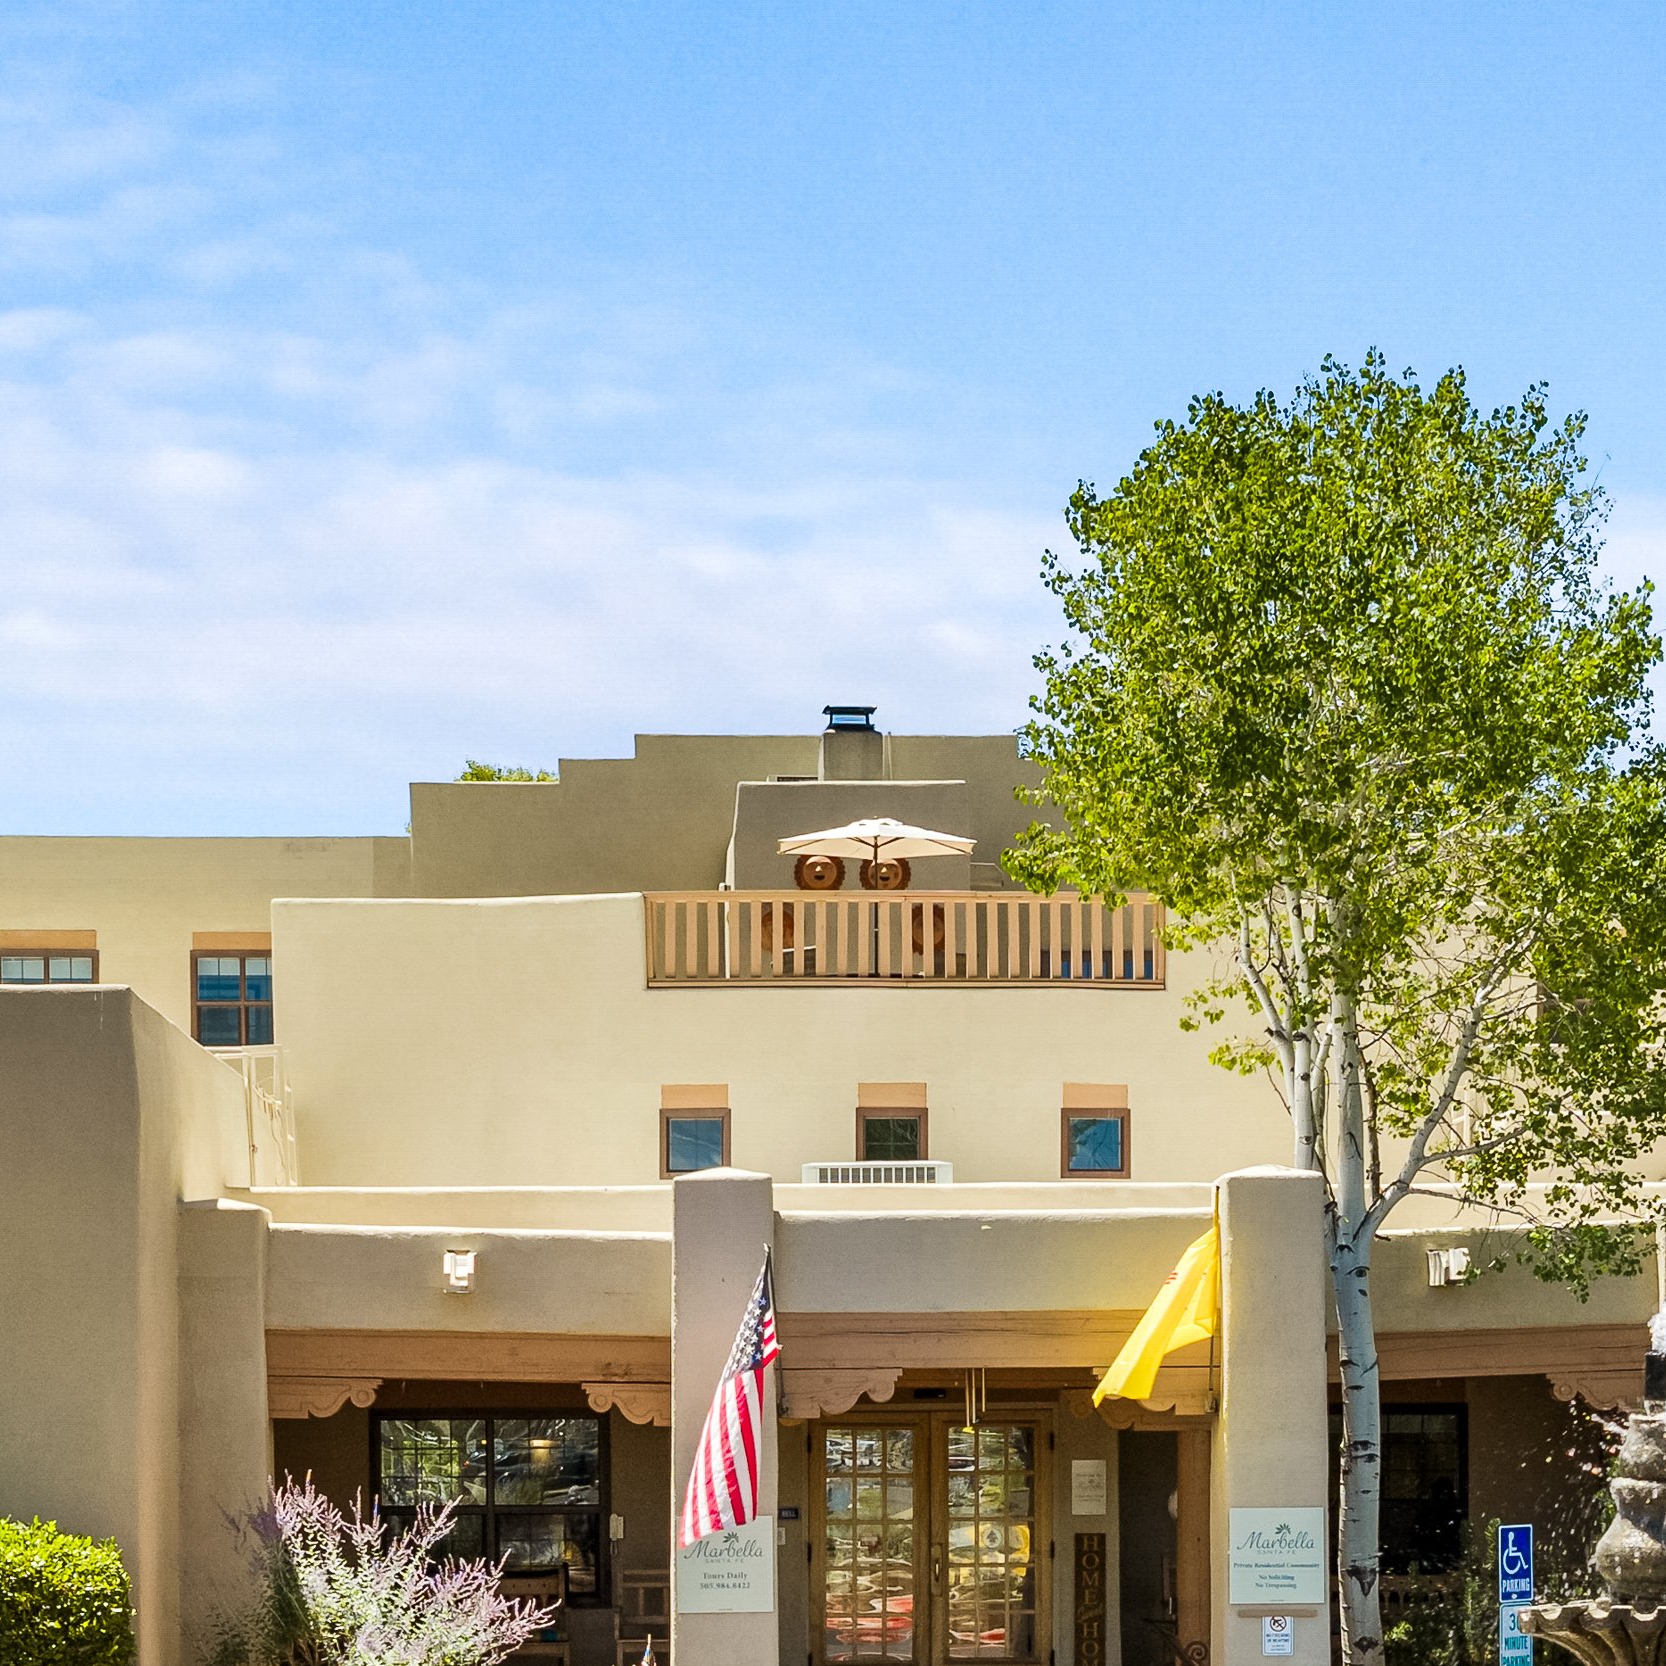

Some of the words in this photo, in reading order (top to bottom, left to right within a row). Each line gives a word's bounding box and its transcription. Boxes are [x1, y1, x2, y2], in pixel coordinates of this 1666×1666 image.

[1236, 1531, 1315, 1550] Marbella
[684, 1540, 765, 1559] Marbella
[727, 1571, 747, 1580] Daily
[1081, 1535, 1100, 1605] HOME
[1502, 1577, 1530, 1593] PARKING
[1504, 1635, 1528, 1650] MINUTE
